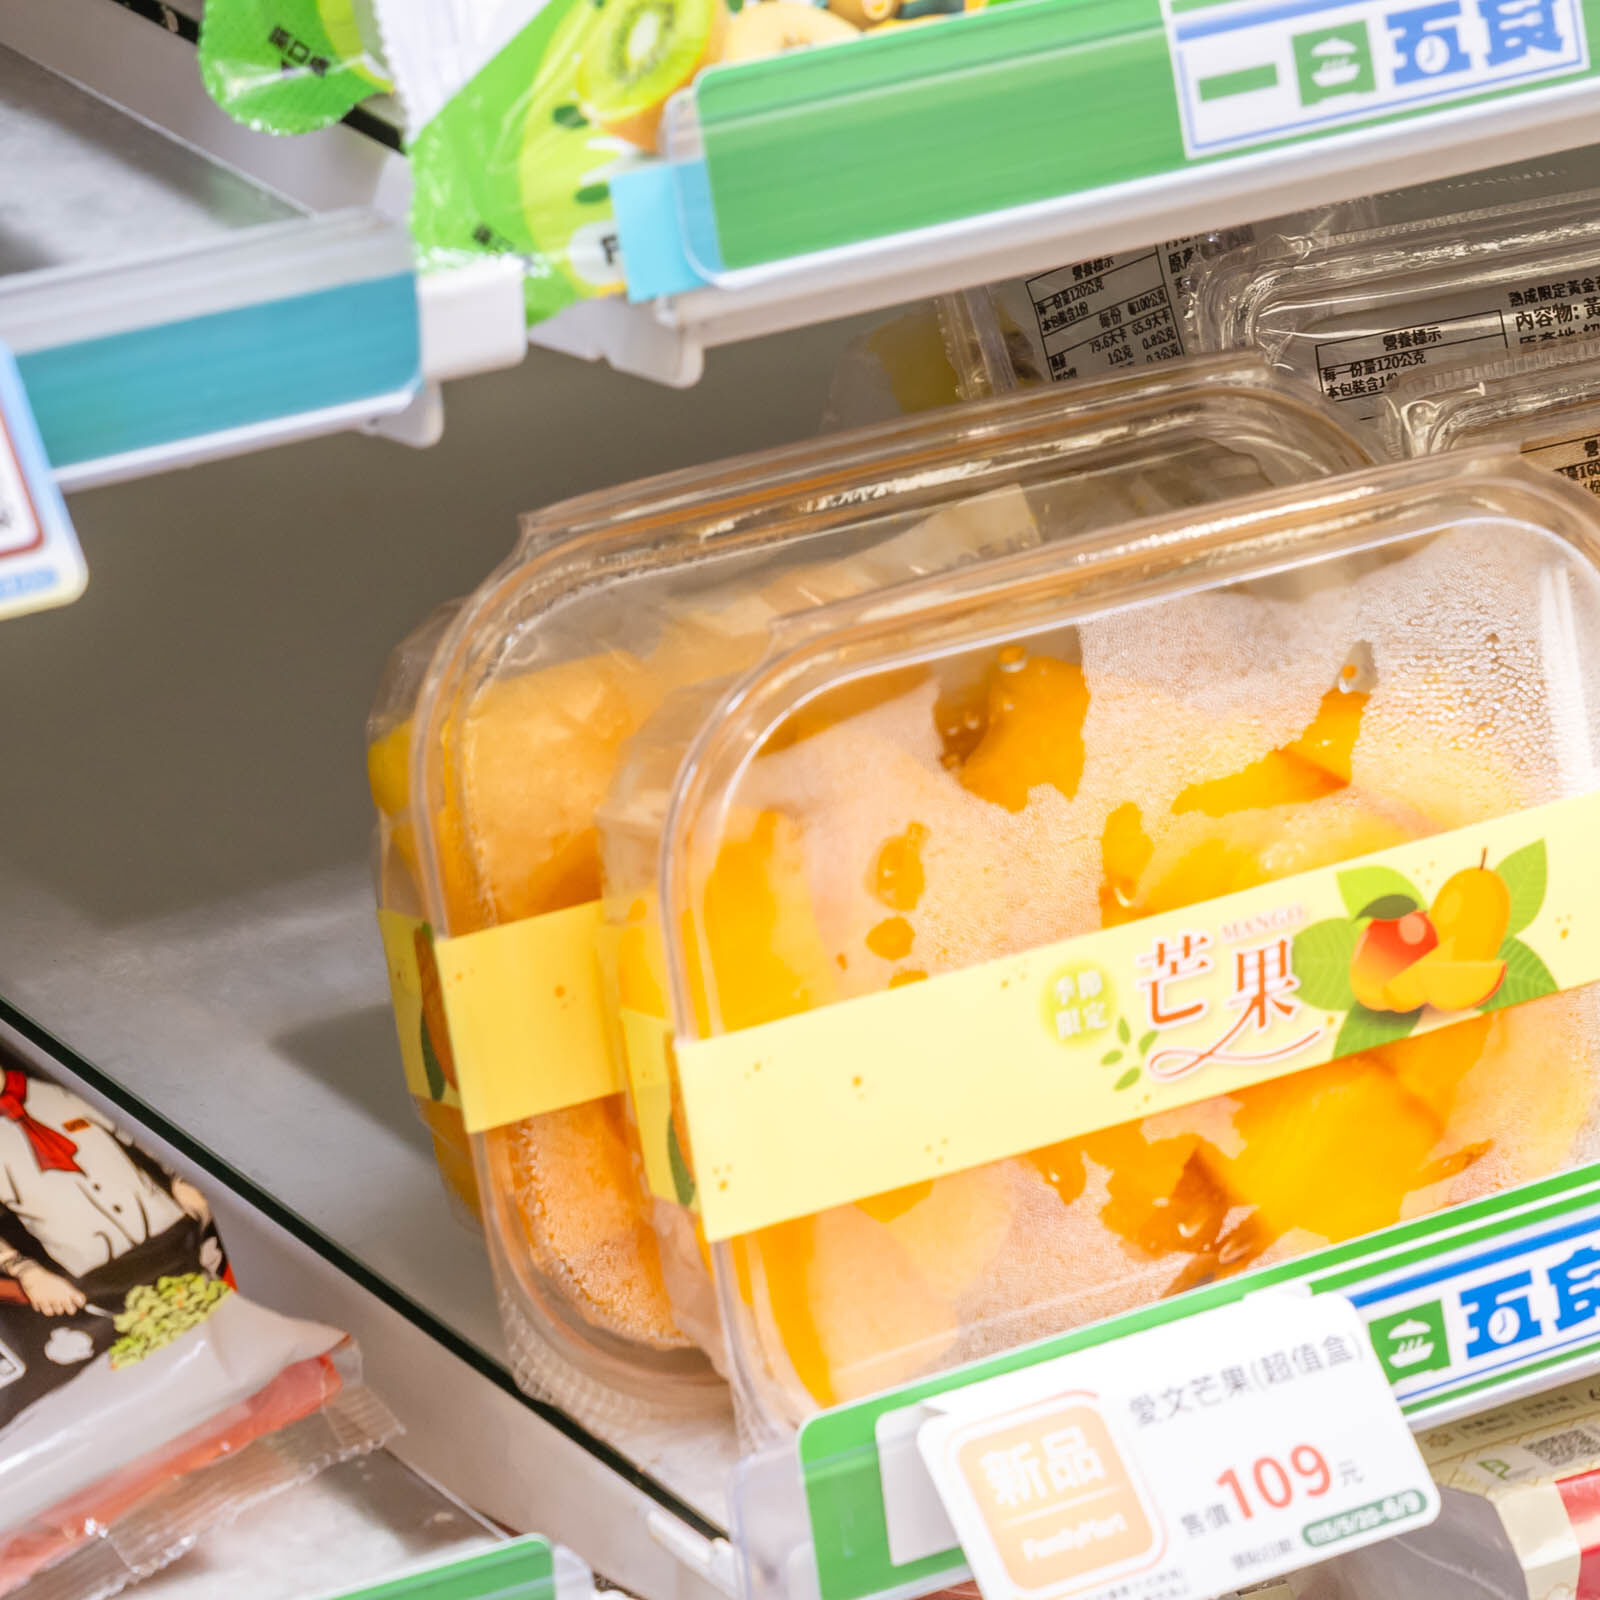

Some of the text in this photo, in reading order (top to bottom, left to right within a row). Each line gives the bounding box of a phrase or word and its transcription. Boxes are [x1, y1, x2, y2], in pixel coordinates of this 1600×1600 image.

[1382, 326, 1444, 352] 營養標示
[1514, 304, 1580, 332] 內容物:
[1137, 932, 1302, 1032] 芒果
[1129, 1332, 1365, 1428] 愛文芒果(超值盒)
[979, 1426, 1107, 1508] 新品
[1216, 1443, 1331, 1520] 109
[1021, 1512, 1129, 1562] FamilyMart
